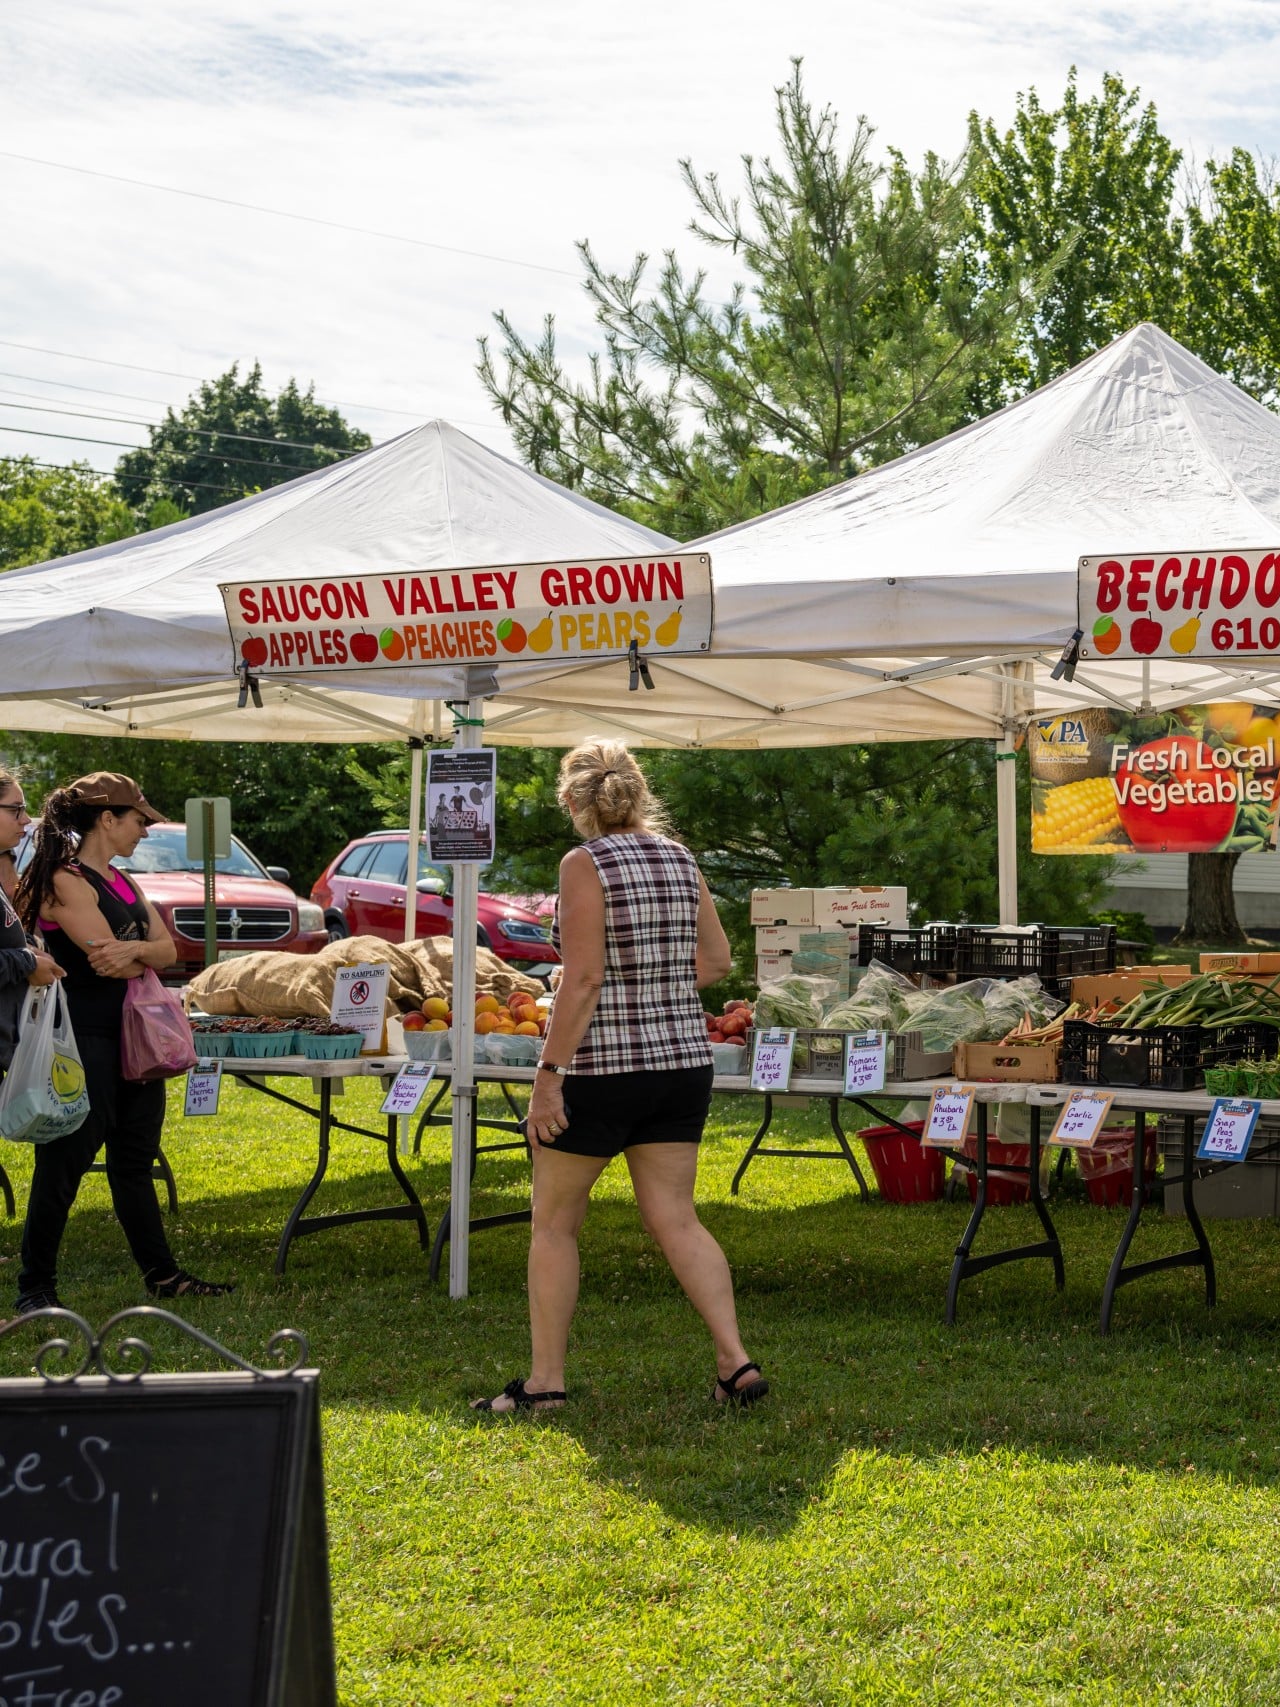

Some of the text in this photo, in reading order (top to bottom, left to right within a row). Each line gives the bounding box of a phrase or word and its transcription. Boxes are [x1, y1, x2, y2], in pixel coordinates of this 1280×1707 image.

[238, 562, 685, 625] SAUCON VALLEY GROWN
[561, 610, 651, 651] PEARS
[404, 619, 498, 660] PEACHES
[269, 628, 349, 667] APPLES
[1059, 720, 1088, 743] PA
[1111, 742, 1188, 772] Fresh
[1197, 737, 1274, 769] Local
[1110, 773, 1275, 812] Vegetables
[832, 899, 890, 914] Farm Fresh Berries
[351, 969, 385, 978] SAMPLING
[758, 1049, 777, 1061] Leaf
[756, 1062, 782, 1072] Lettuce
[854, 1064, 878, 1074] Lettuce
[189, 1078, 210, 1088] Sweet
[395, 1080, 418, 1090] Yellow
[934, 1103, 964, 1114] Rhubarb
[1067, 1108, 1093, 1119] Garlic
[1214, 1118, 1236, 1128] Snap
[1216, 1126, 1232, 1136] Peas
